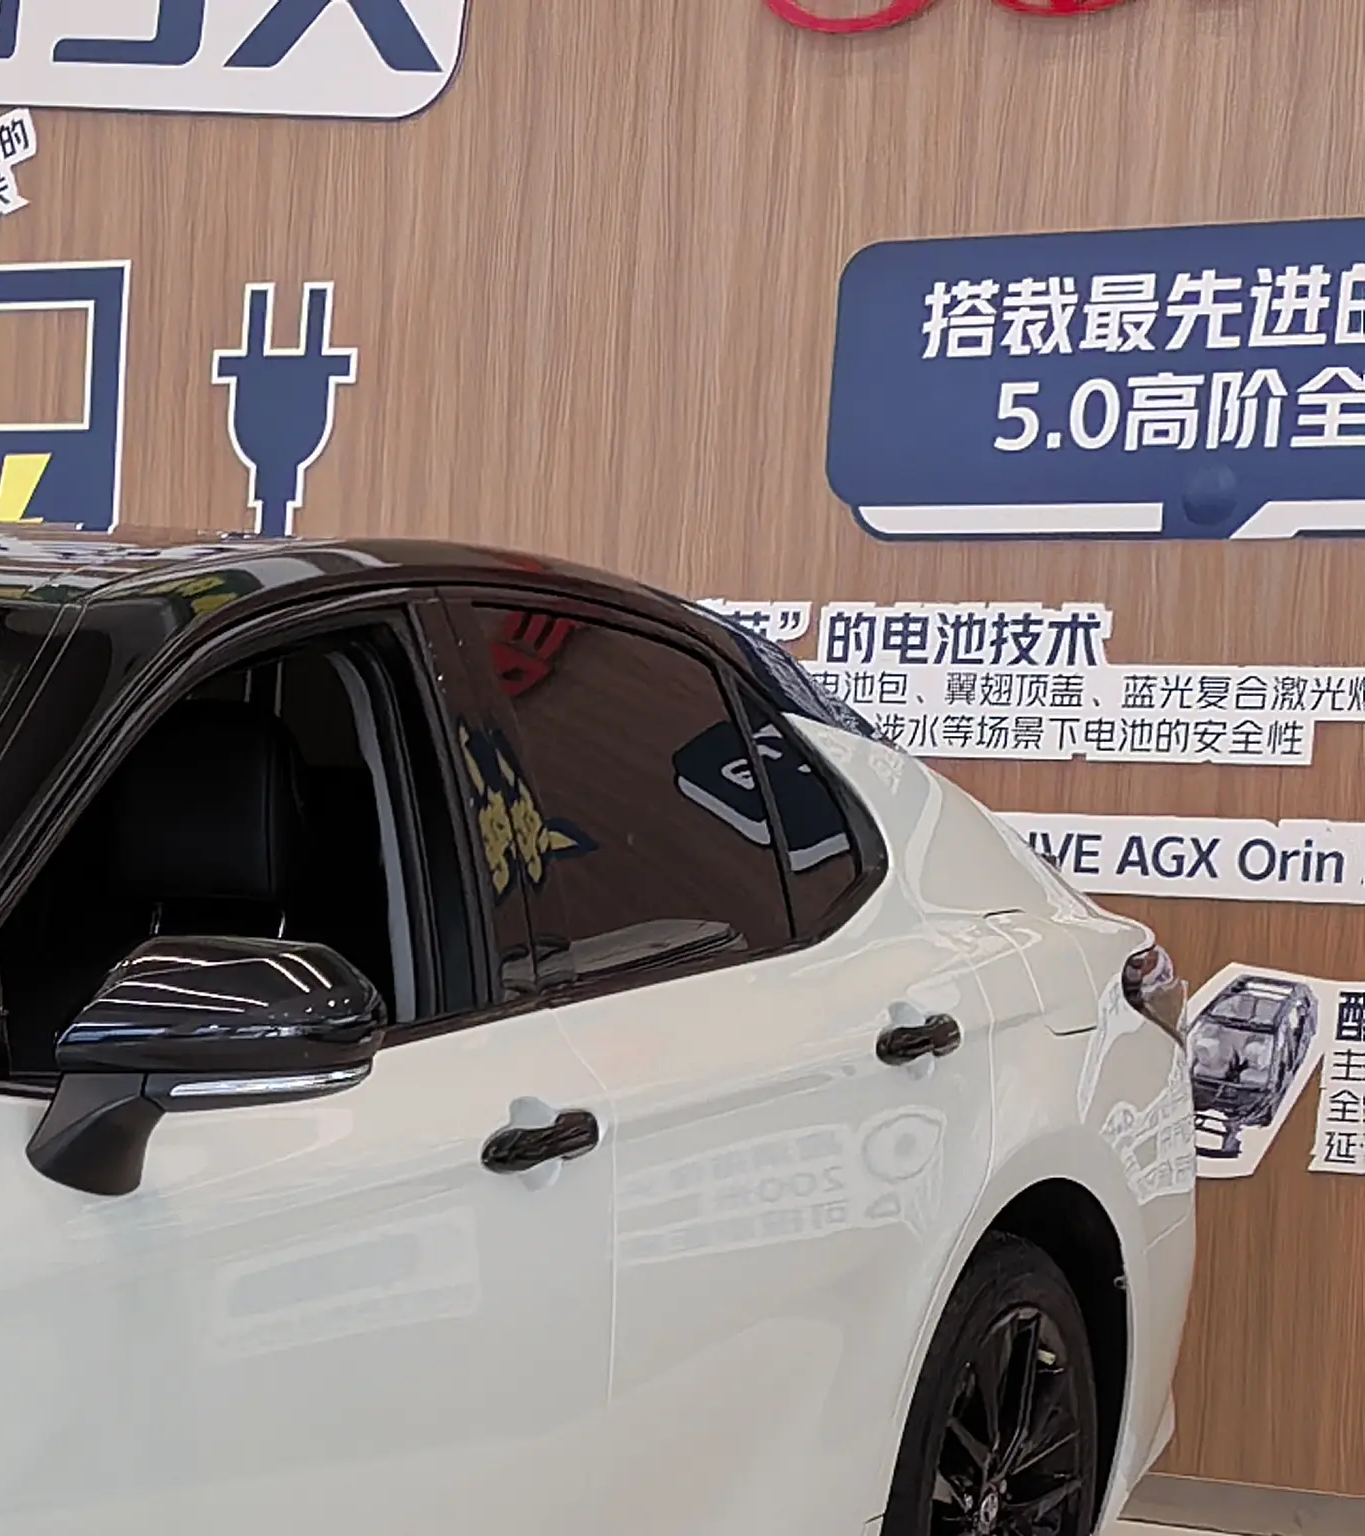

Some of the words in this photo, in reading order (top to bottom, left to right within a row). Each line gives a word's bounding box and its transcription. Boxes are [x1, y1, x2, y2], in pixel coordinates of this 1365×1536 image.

[875, 714, 1305, 756] 涉水等场景下电池的安全性
[1116, 835, 1221, 878] AGX
[1238, 836, 1345, 884] Orin
[1326, 1089, 1365, 1122] 全
[1324, 1131, 1365, 1164] 延
